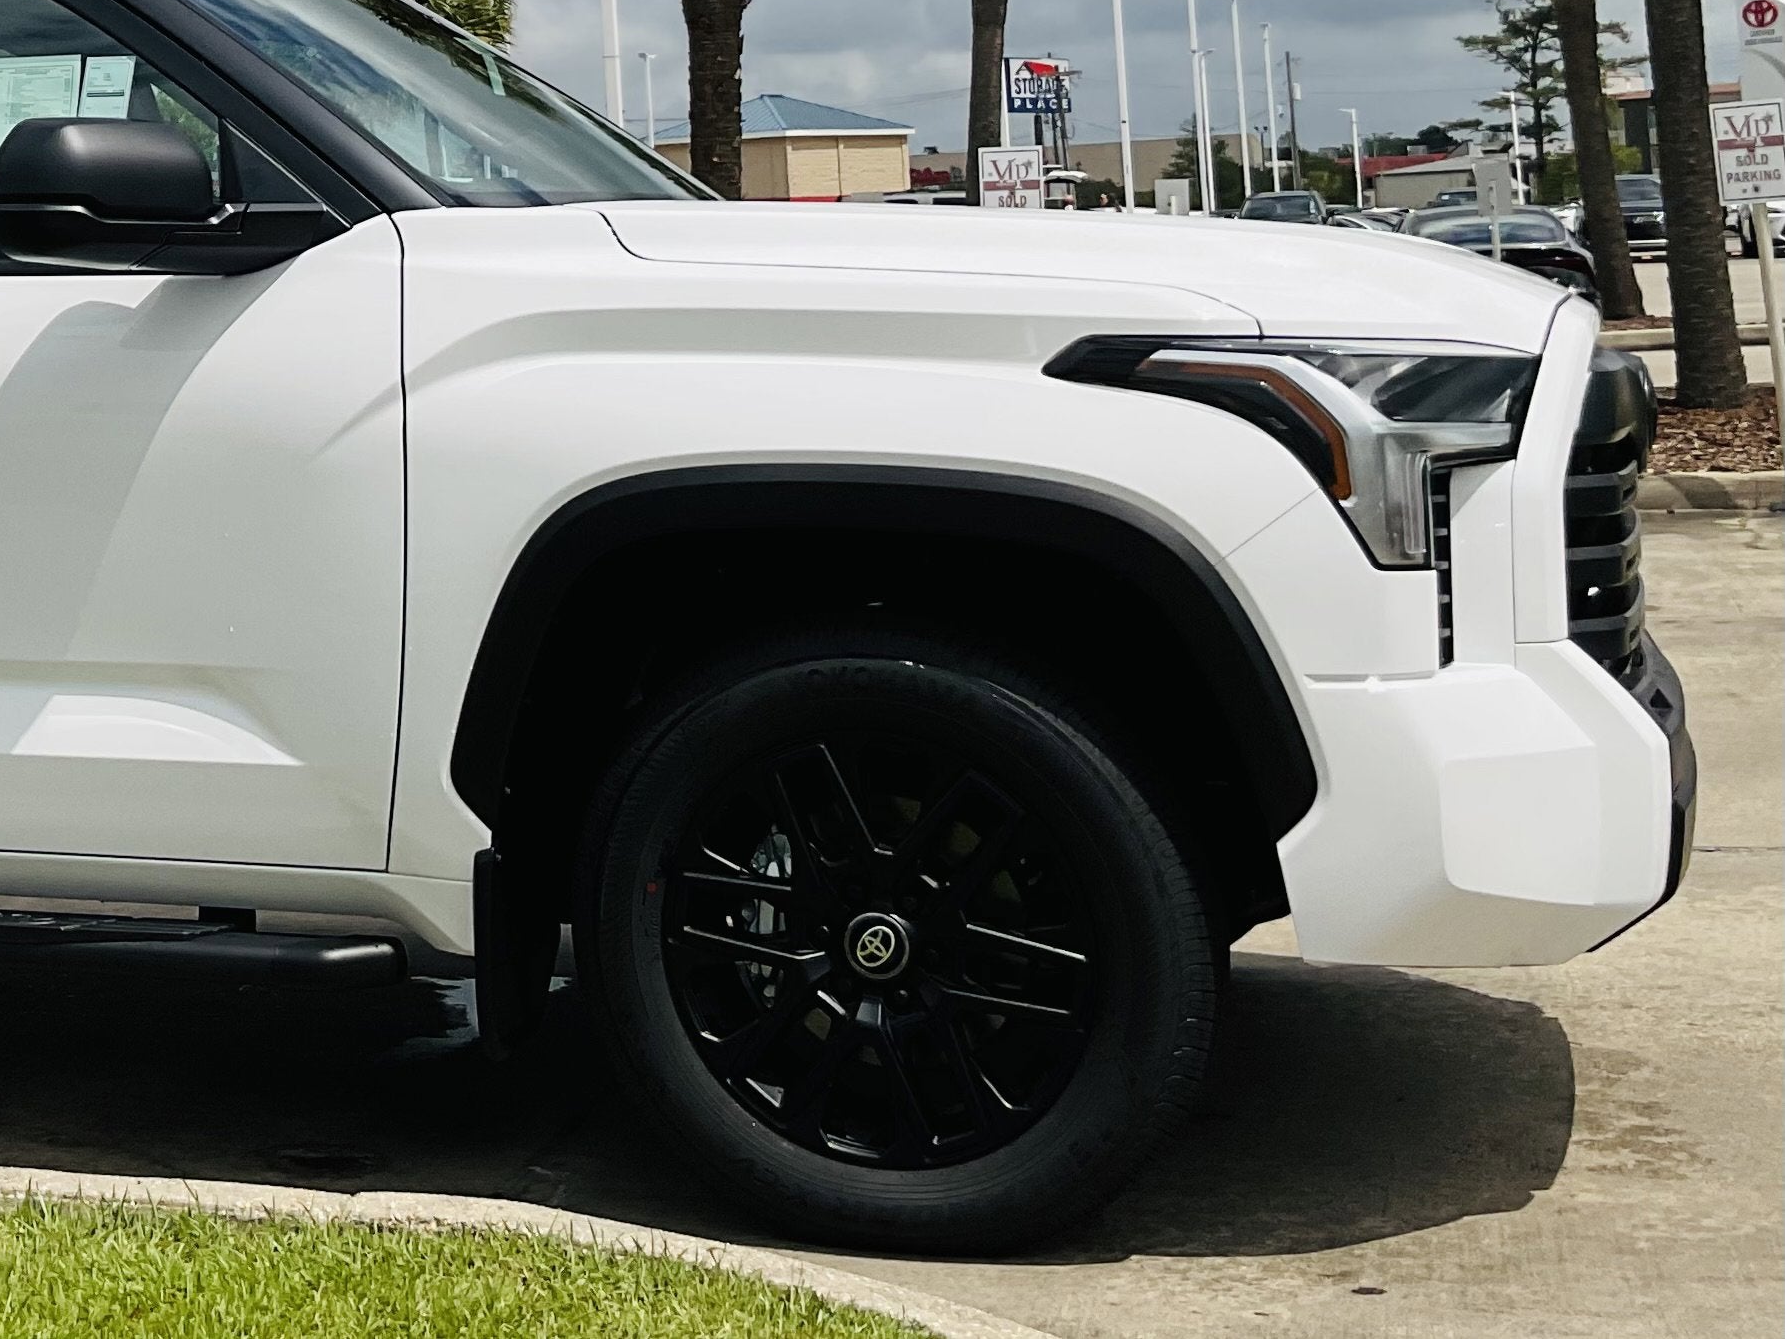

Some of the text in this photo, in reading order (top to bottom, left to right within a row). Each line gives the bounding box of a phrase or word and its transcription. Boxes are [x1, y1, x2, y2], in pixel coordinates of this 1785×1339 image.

[1014, 98, 1069, 109] PLACE
[1735, 153, 1768, 167] SOLD
[1726, 168, 1781, 184] PARKING
[998, 194, 1027, 208] SOLD
